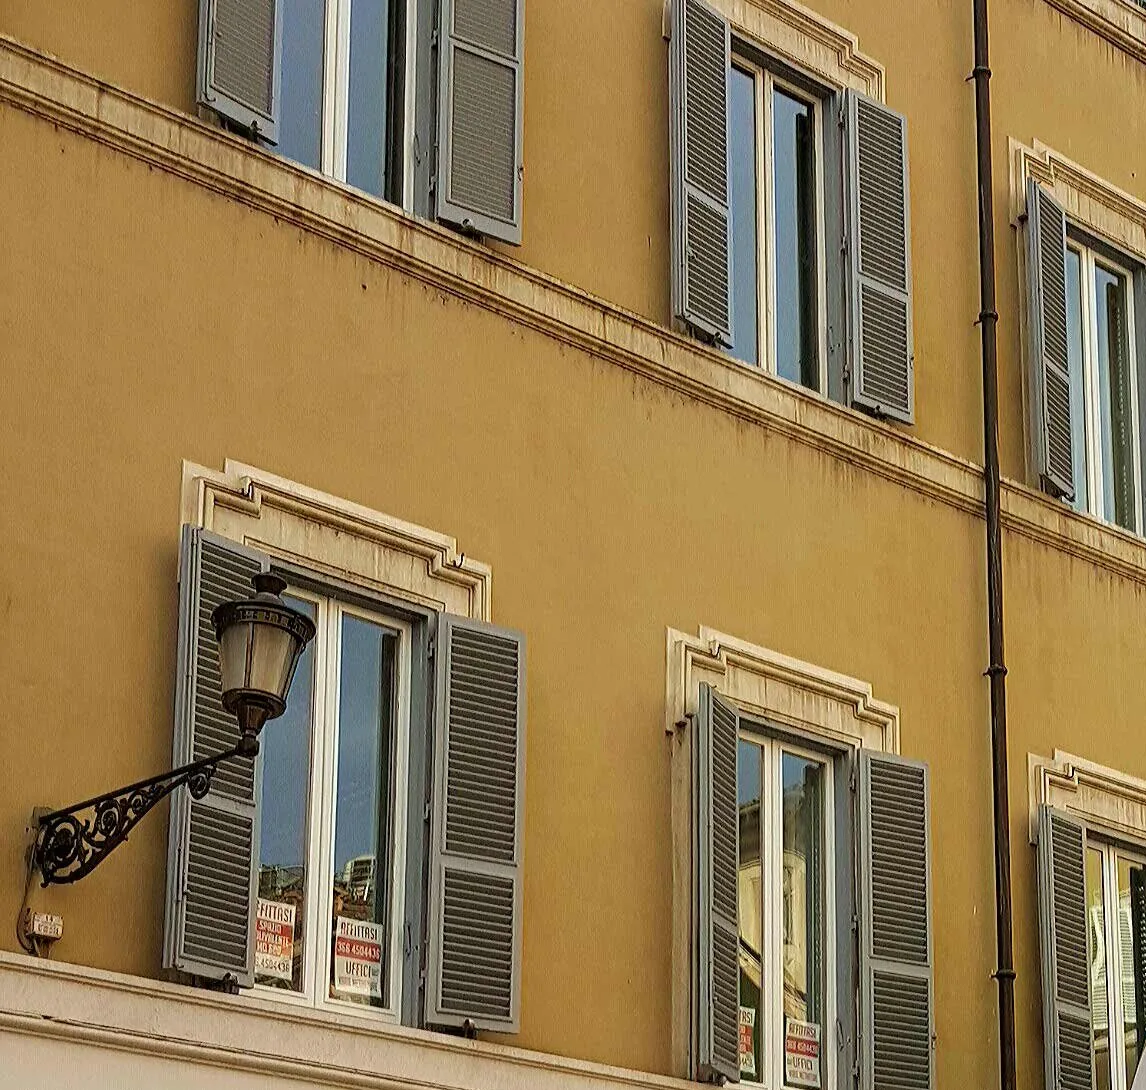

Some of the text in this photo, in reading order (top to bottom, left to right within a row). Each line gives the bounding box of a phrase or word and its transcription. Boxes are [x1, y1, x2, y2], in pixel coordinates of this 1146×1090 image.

[256, 902, 293, 923] FITTASI
[340, 921, 378, 941] AFFITTASI
[345, 959, 371, 979] UFFICI
